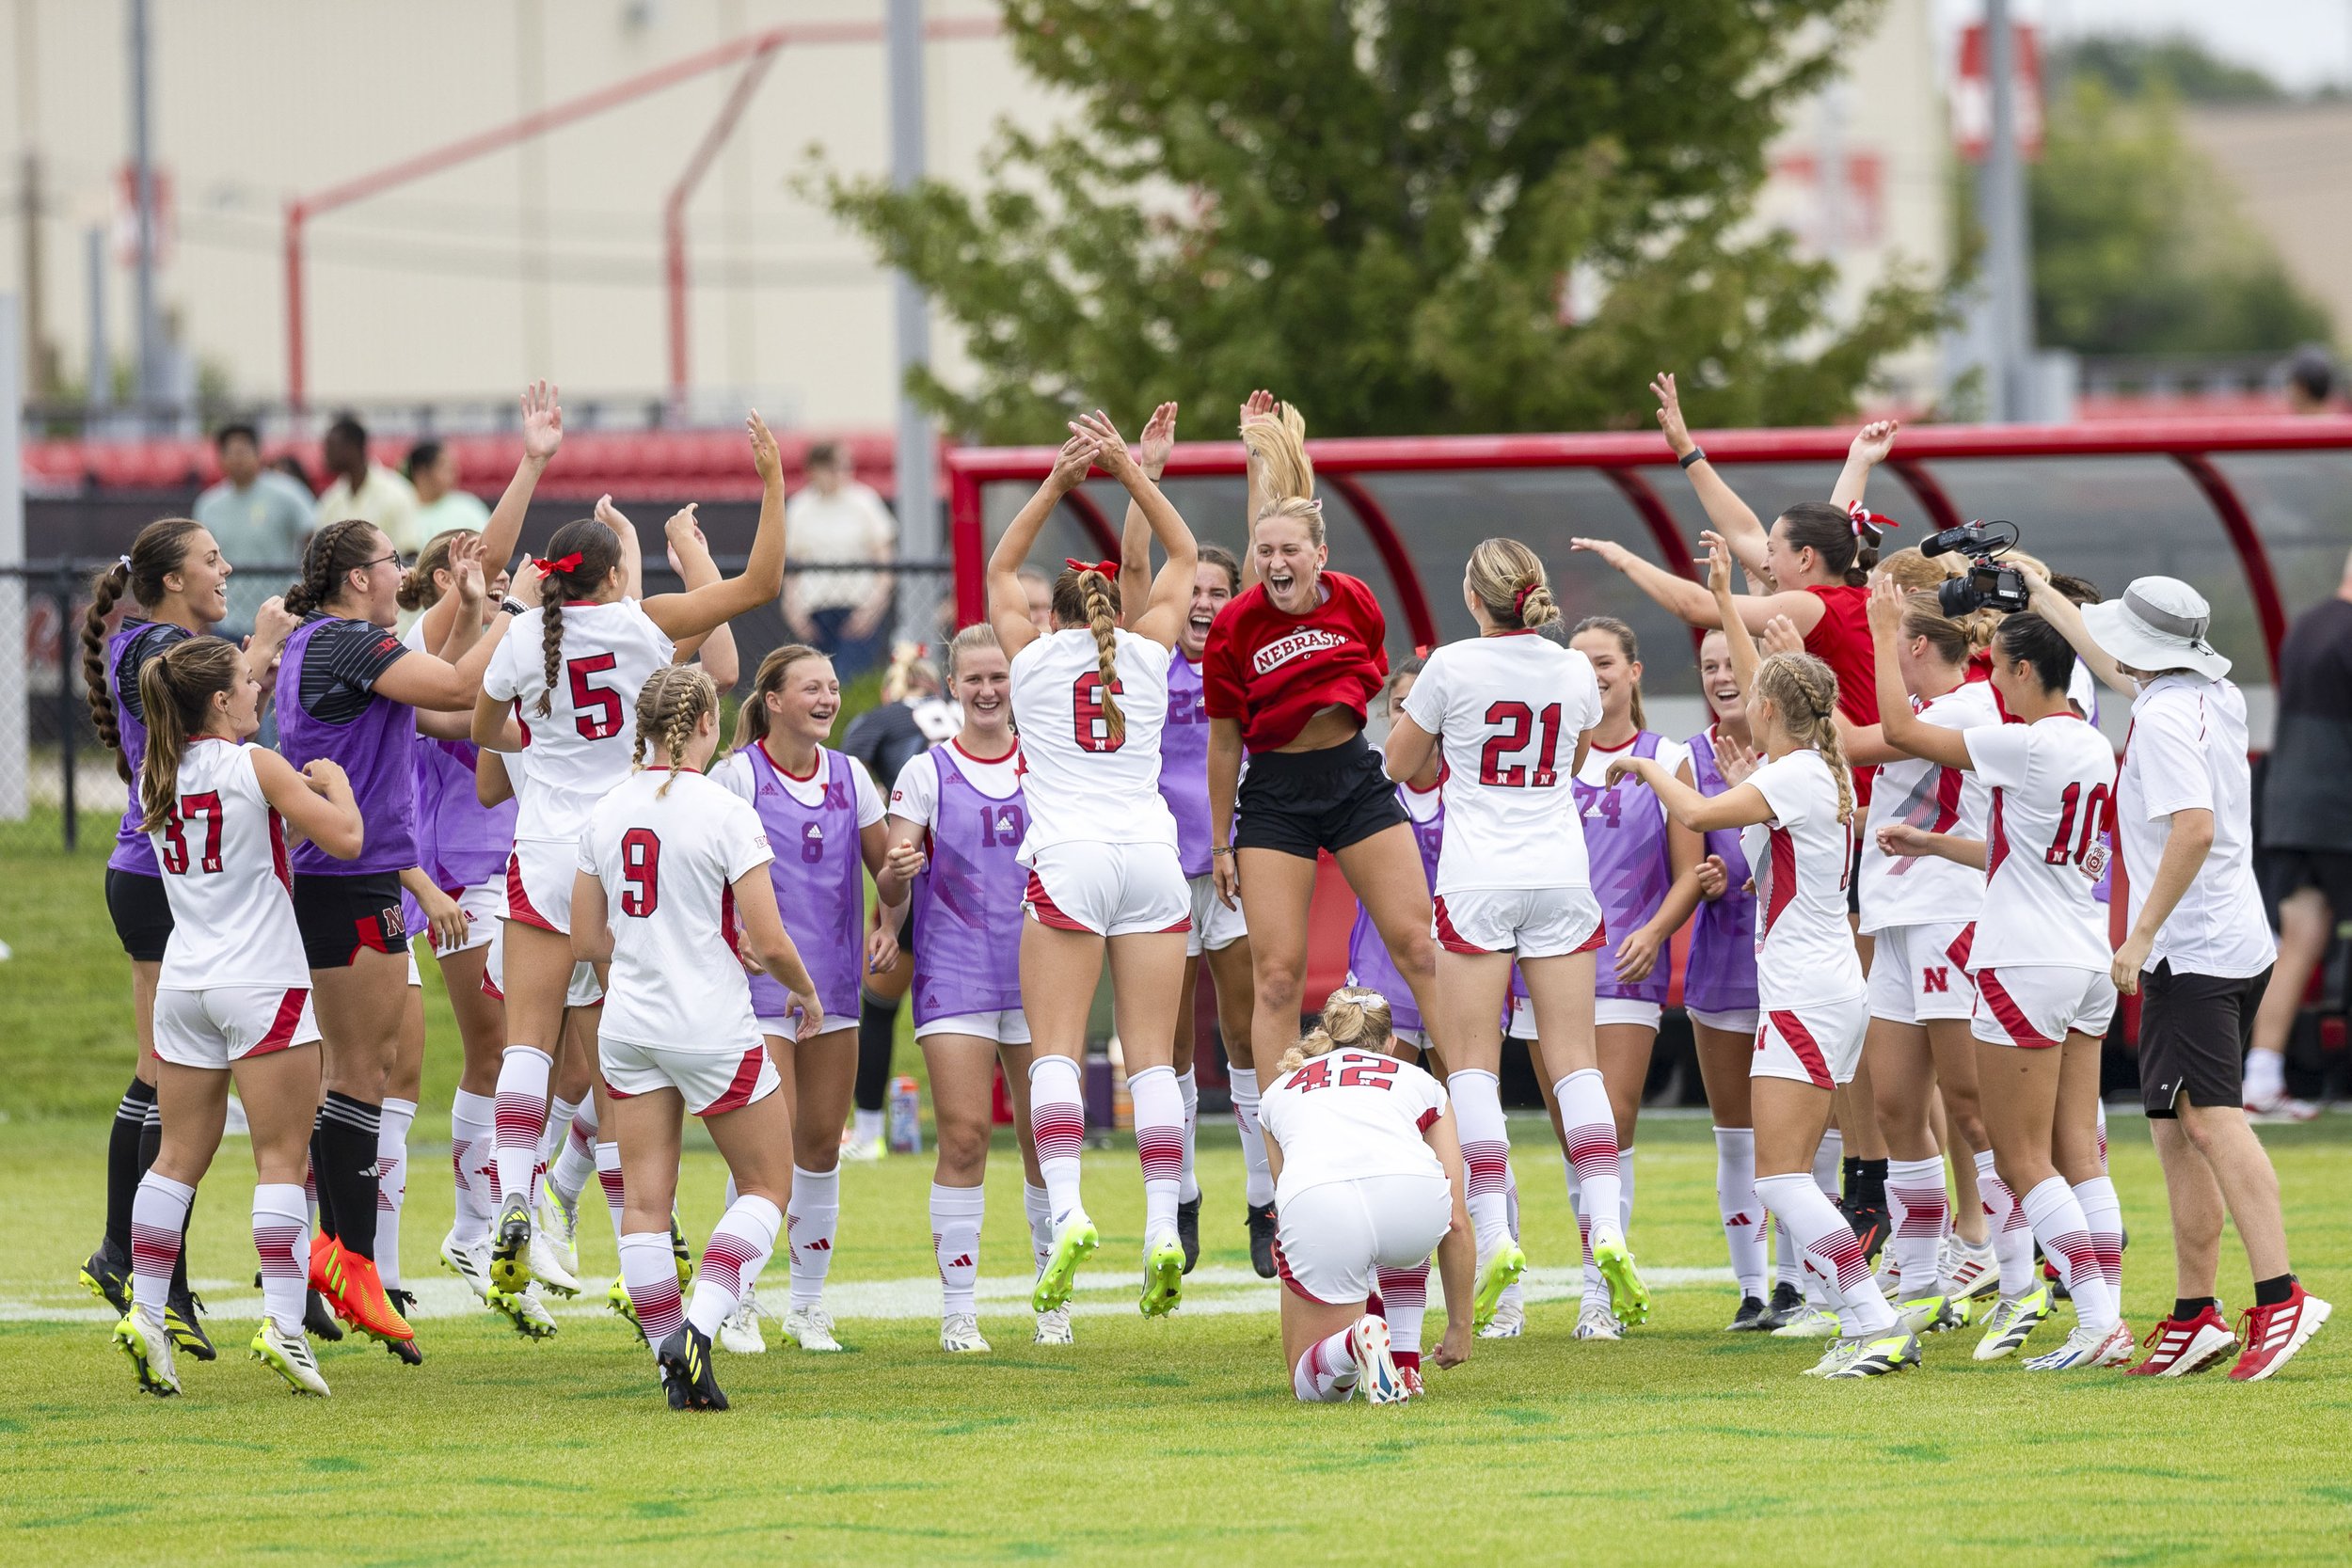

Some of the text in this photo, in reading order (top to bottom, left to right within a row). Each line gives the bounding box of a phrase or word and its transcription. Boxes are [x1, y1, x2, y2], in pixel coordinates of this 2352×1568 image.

[1256, 631, 1348, 672] NEBRASK
[566, 652, 624, 741] 5
[1073, 671, 1126, 752] 6
[596, 725, 607, 736] N
[1094, 739, 1105, 751] N
[1479, 701, 1562, 788] 21
[1497, 773, 1507, 784] N
[1540, 774, 1550, 784] N
[979, 804, 1024, 847] 19
[1574, 787, 1621, 828] 74
[2044, 782, 2109, 865] 10
[162, 789, 223, 875] 37
[802, 822, 823, 863] 8
[208, 859, 217, 870] N
[621, 828, 660, 918] 9
[2053, 851, 2064, 863] N
[383, 905, 405, 937] N
[634, 903, 642, 915] N
[1923, 966, 1948, 993] N
[1284, 1053, 1399, 1094] 42
